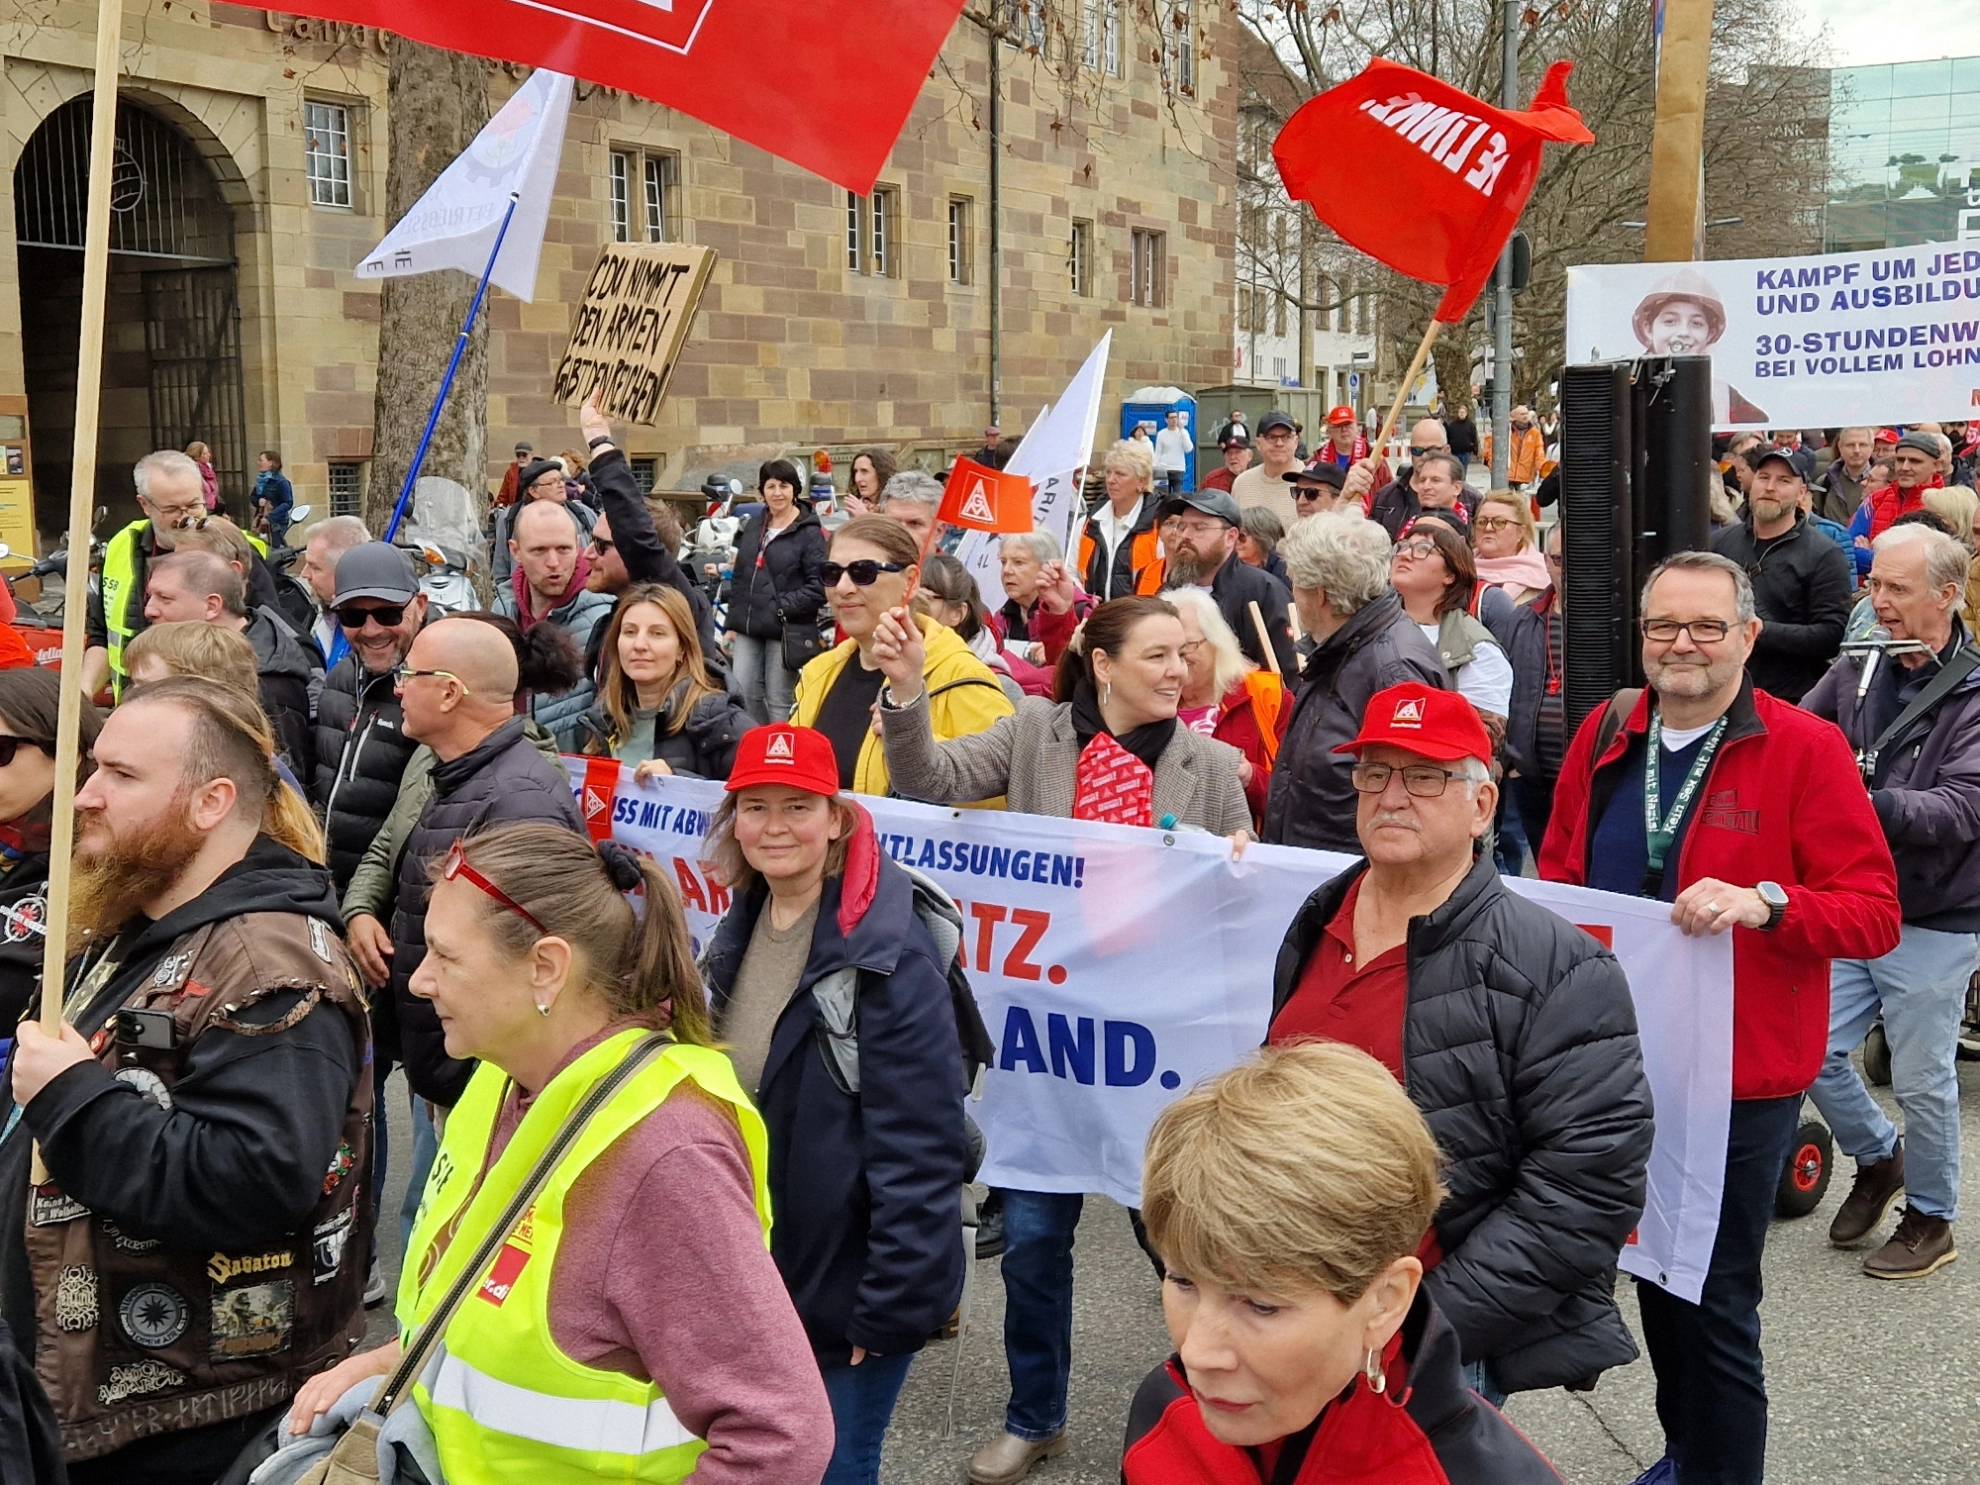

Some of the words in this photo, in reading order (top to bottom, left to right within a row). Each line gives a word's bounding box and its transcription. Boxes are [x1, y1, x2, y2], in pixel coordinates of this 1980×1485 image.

[587, 254, 630, 300] CDU
[624, 257, 690, 308] NIMMT
[1756, 263, 1861, 290] KAMPF
[1871, 258, 1916, 281] UM
[1756, 292, 1820, 316] UND
[1830, 277, 1980, 311] AUSBILDU
[572, 303, 608, 348] DEN
[600, 303, 671, 356] ARMEN
[1755, 320, 1980, 356] 30-STUNDENW
[1755, 360, 1795, 378] BEI
[1805, 353, 1904, 376] VOLLEM
[1913, 347, 1980, 369] LOHN
[1646, 768, 1658, 791] mit
[1663, 804, 1685, 835] Kein
[1680, 779, 1698, 802] Sex
[1693, 755, 1711, 778] mit
[639, 802, 674, 832] MIT
[987, 1005, 1182, 1091] AND.
[207, 1251, 294, 1285] Sabaton
